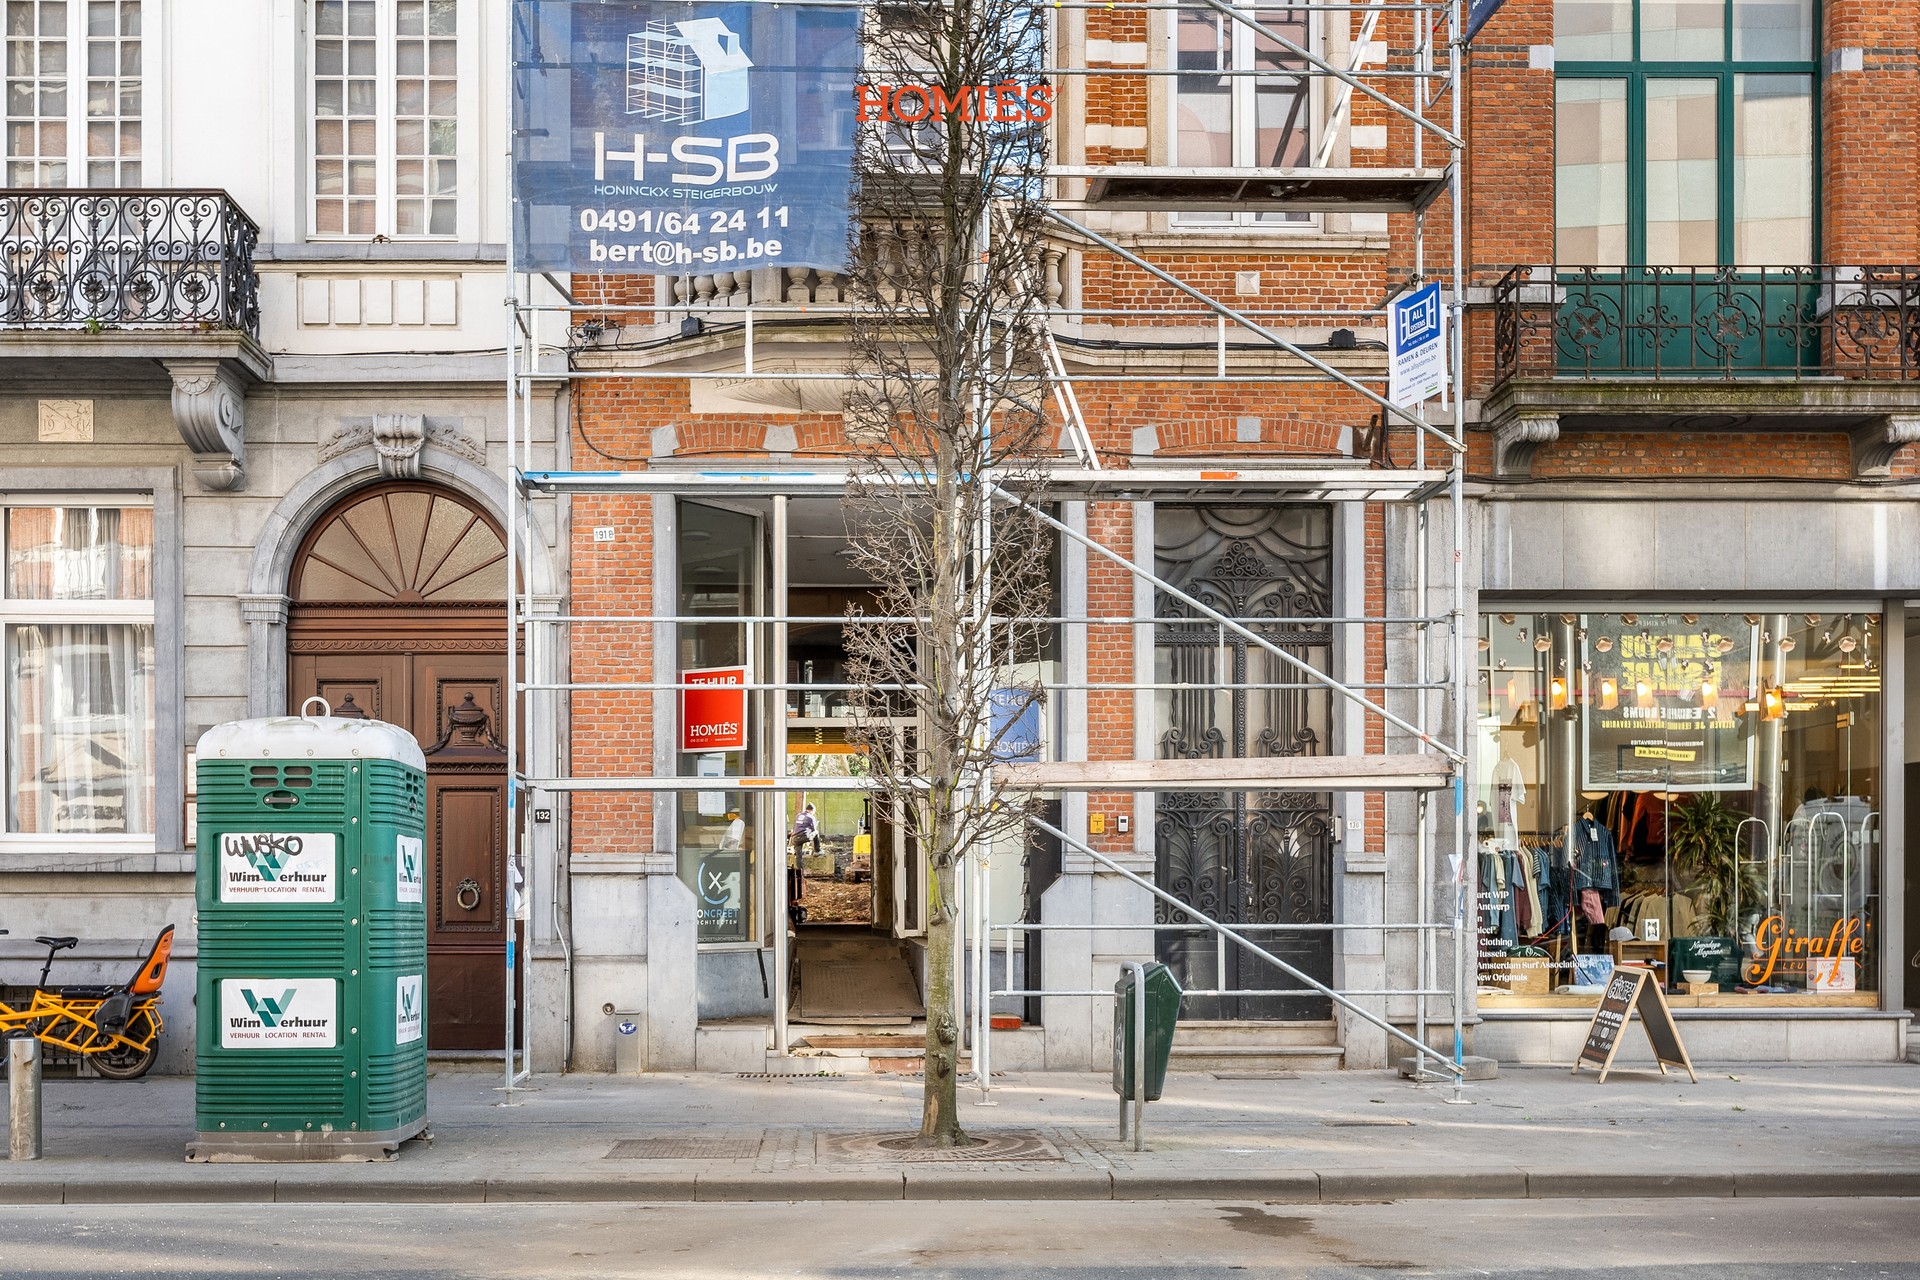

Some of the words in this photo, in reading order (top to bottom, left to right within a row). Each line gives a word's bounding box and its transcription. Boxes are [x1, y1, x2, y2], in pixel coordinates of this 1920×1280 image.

[594, 132, 779, 185] H-SB
[594, 184, 670, 198] HONINCKX
[672, 183, 779, 200] STEIGERBOUW
[580, 208, 701, 235] 0491/64
[709, 209, 747, 233] 24
[757, 205, 789, 229] 11
[590, 237, 783, 266] bert@h-sb.be
[1412, 308, 1424, 321] ALL
[689, 722, 739, 737] HOMIÉS
[536, 811, 550, 820] 132
[229, 872, 260, 882] Wim
[1476, 891, 1491, 899] artt
[1492, 890, 1509, 899] WIP
[1476, 902, 1510, 912] Antwerp
[1480, 938, 1513, 946] Clothing
[1745, 915, 1863, 985] Giraffe
[1477, 961, 1521, 969] Amsterdam
[1521, 961, 1539, 969] Surf
[1492, 973, 1528, 983] Originals
[230, 1017, 261, 1028] Wim
